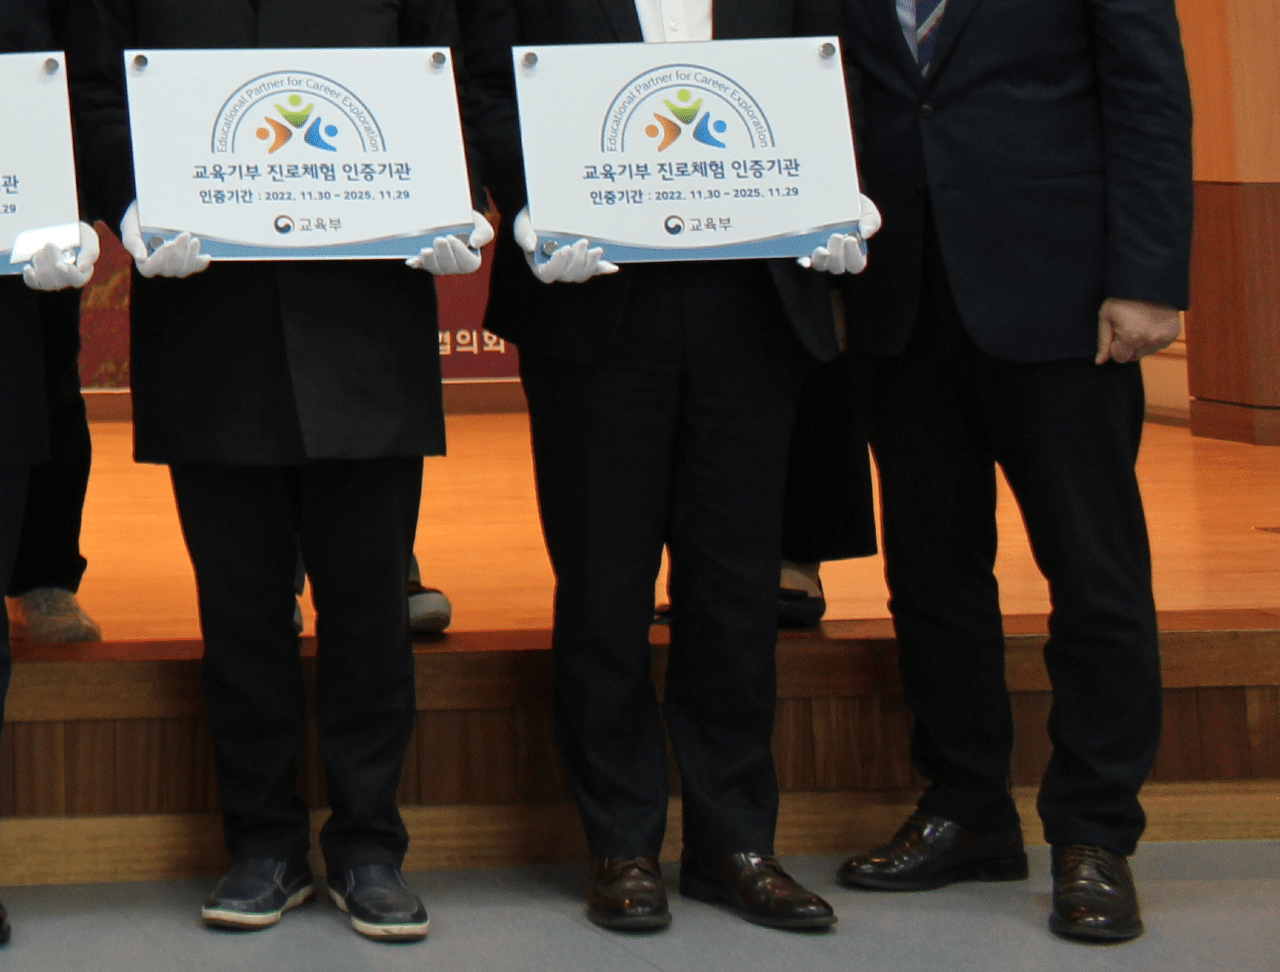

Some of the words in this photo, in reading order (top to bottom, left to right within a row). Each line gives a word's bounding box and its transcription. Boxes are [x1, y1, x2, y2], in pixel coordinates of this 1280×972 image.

[217, 94, 249, 152] Educational
[245, 79, 283, 99] Partner
[287, 76, 302, 85] for
[306, 79, 341, 98] Career
[341, 95, 378, 151] Exploration
[606, 90, 637, 151] Educational
[634, 73, 672, 94] Partner
[675, 70, 690, 80] for
[694, 72, 730, 92] Career
[730, 88, 767, 147] Exploration
[193, 164, 261, 182] 교육기부
[268, 163, 336, 182] 진로체험
[342, 163, 411, 182] 인증기관
[583, 163, 651, 182] 교육기부
[657, 161, 725, 181] 진로체험
[731, 158, 800, 179] 인증기관
[199, 190, 253, 204] 인증기간
[265, 192, 296, 200] 2022.
[301, 191, 331, 200] 11.30
[344, 191, 375, 200] 2025.
[379, 190, 410, 199] 11.29
[590, 189, 643, 205] 인증기간
[655, 191, 686, 200] 2022.
[690, 189, 721, 199] 11.30
[733, 188, 764, 198] 2025.
[768, 187, 799, 196] 11.29
[300, 218, 341, 231] 교육부
[690, 217, 731, 231] 교육부
